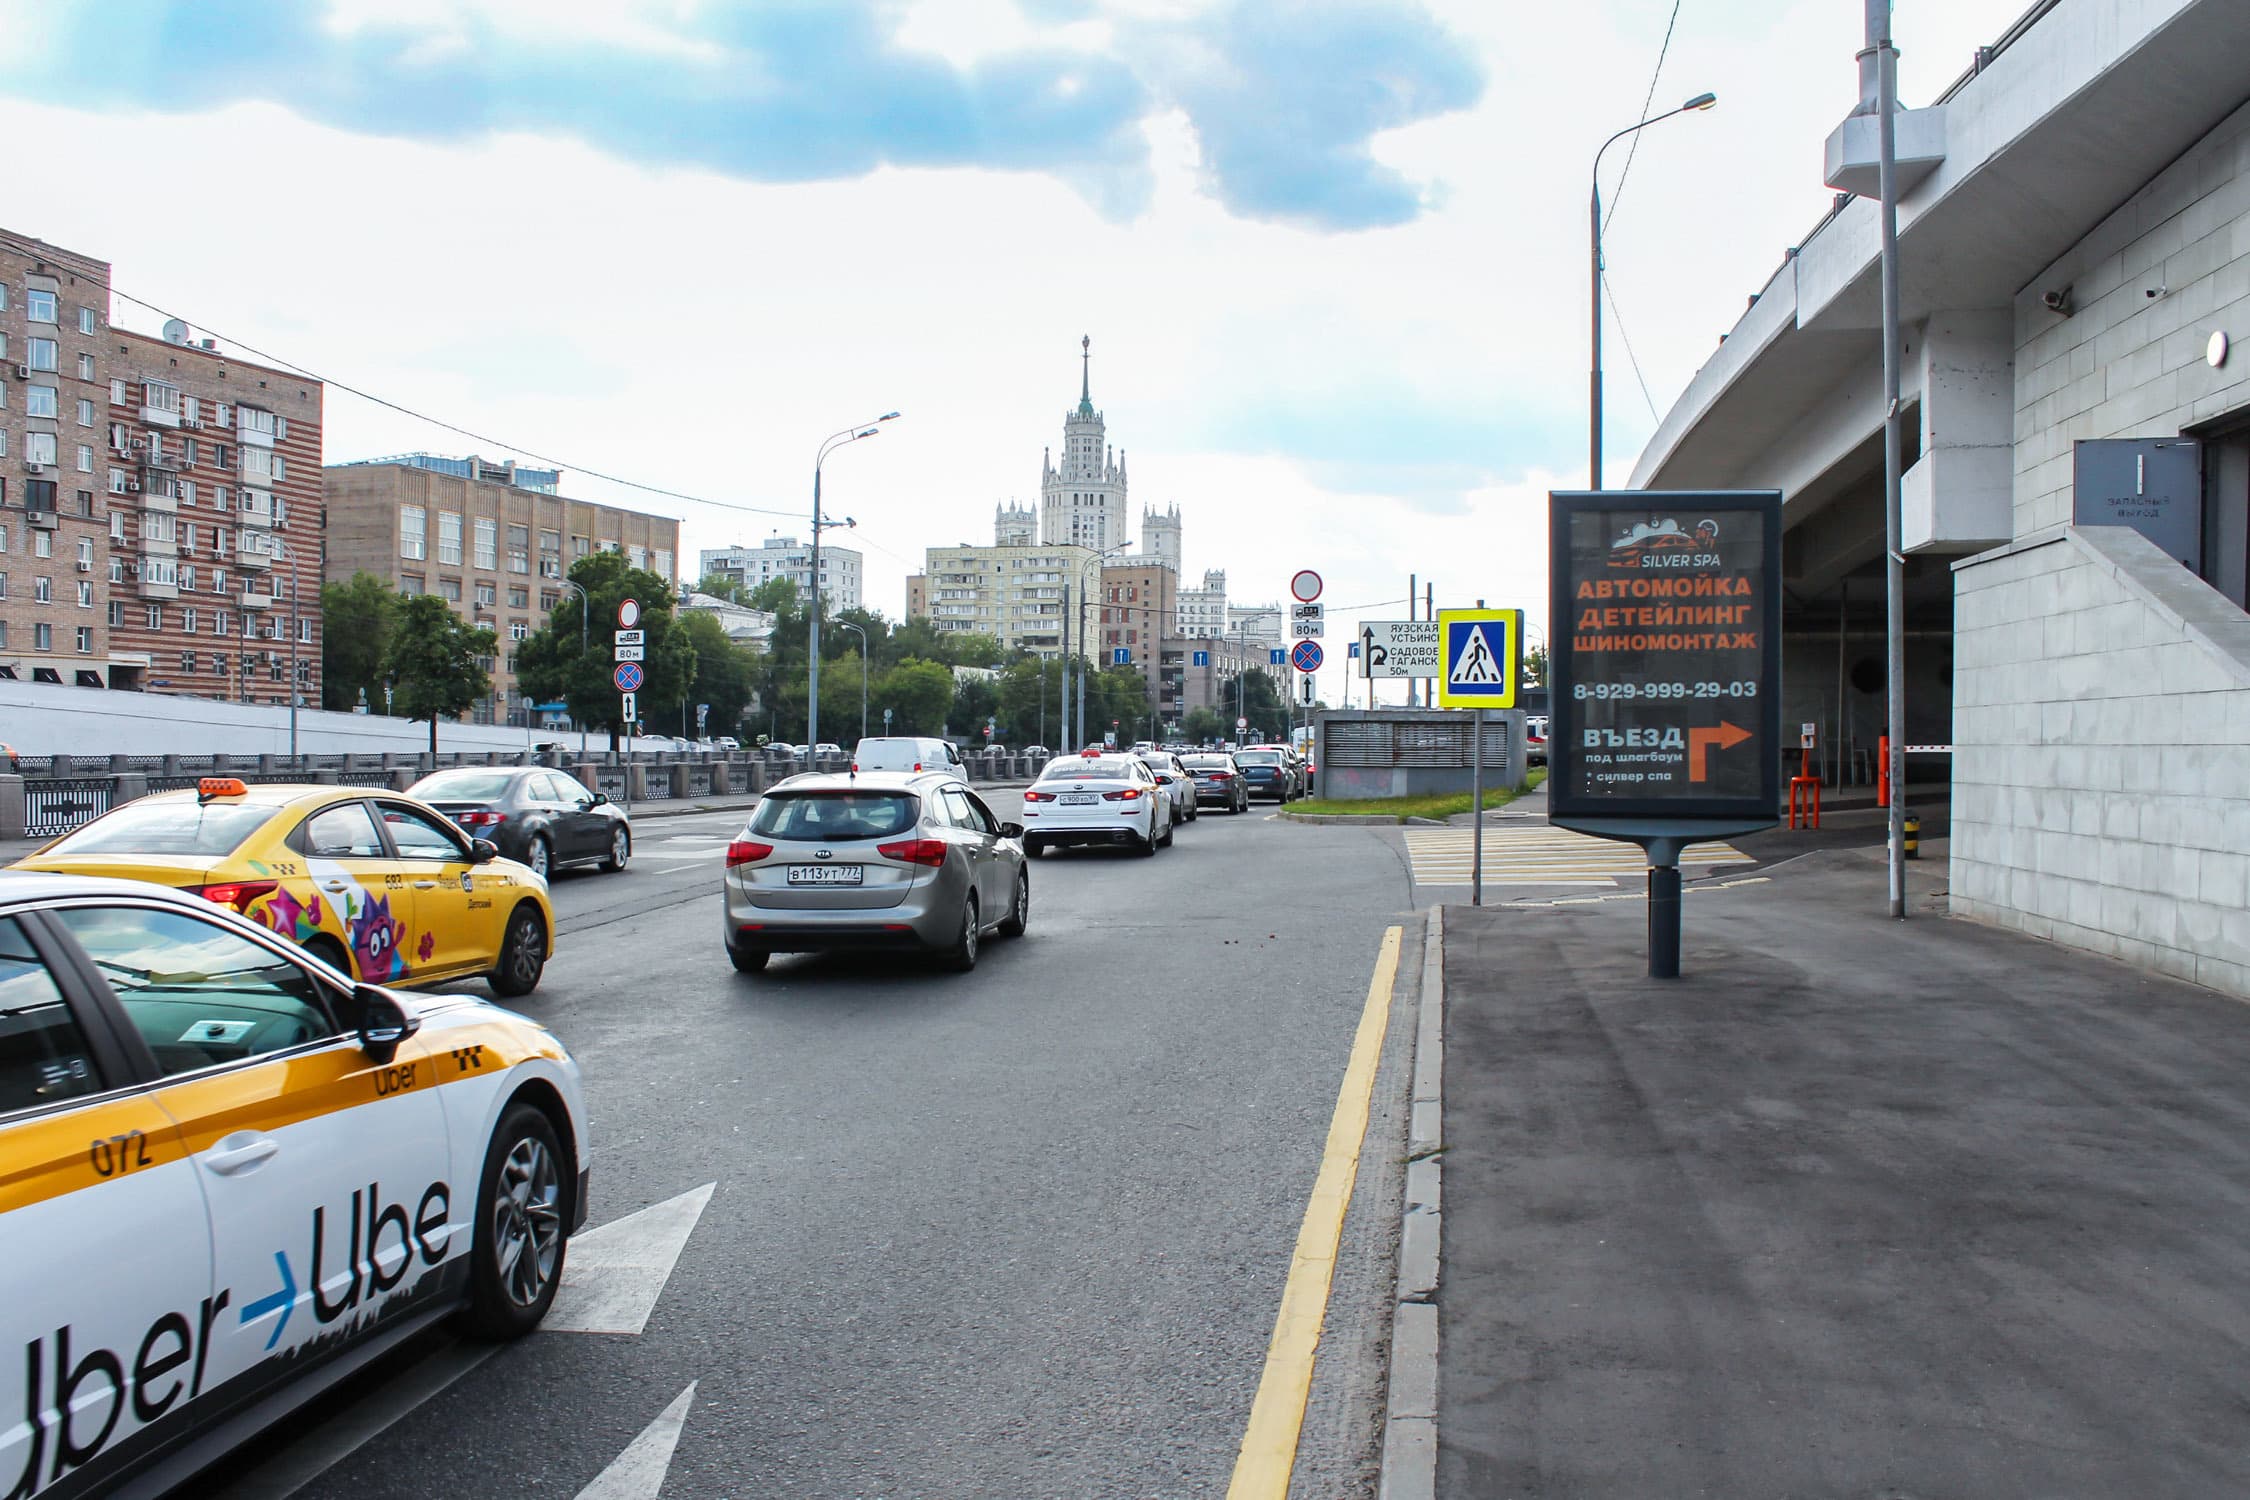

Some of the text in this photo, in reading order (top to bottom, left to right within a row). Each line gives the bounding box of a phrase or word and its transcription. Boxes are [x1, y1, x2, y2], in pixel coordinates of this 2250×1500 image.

[1641, 554, 1721, 568] SILVER SPA
[1577, 573, 1752, 600] АВТОМОЙКА
[1578, 602, 1752, 631] ДЕТЕЙЛИНГ
[1296, 625, 1319, 635] 80м
[1390, 624, 1438, 633] ЯУЗСКАЯ
[1573, 633, 1757, 652] ШИНОМОНТАЖ
[1390, 647, 1438, 656] САДОВОЕ
[1390, 667, 1409, 676] 50м
[1573, 681, 1757, 700] 8-929-999-29-03
[1583, 727, 1685, 750] ВЪЕЗД
[1585, 752, 1683, 764] под шлагбаум
[1596, 772, 1672, 783] силвер спа
[840, 866, 858, 877] 777
[385, 873, 403, 890] 683
[374, 1063, 416, 1096] Uber
[90, 1130, 152, 1177] 072
